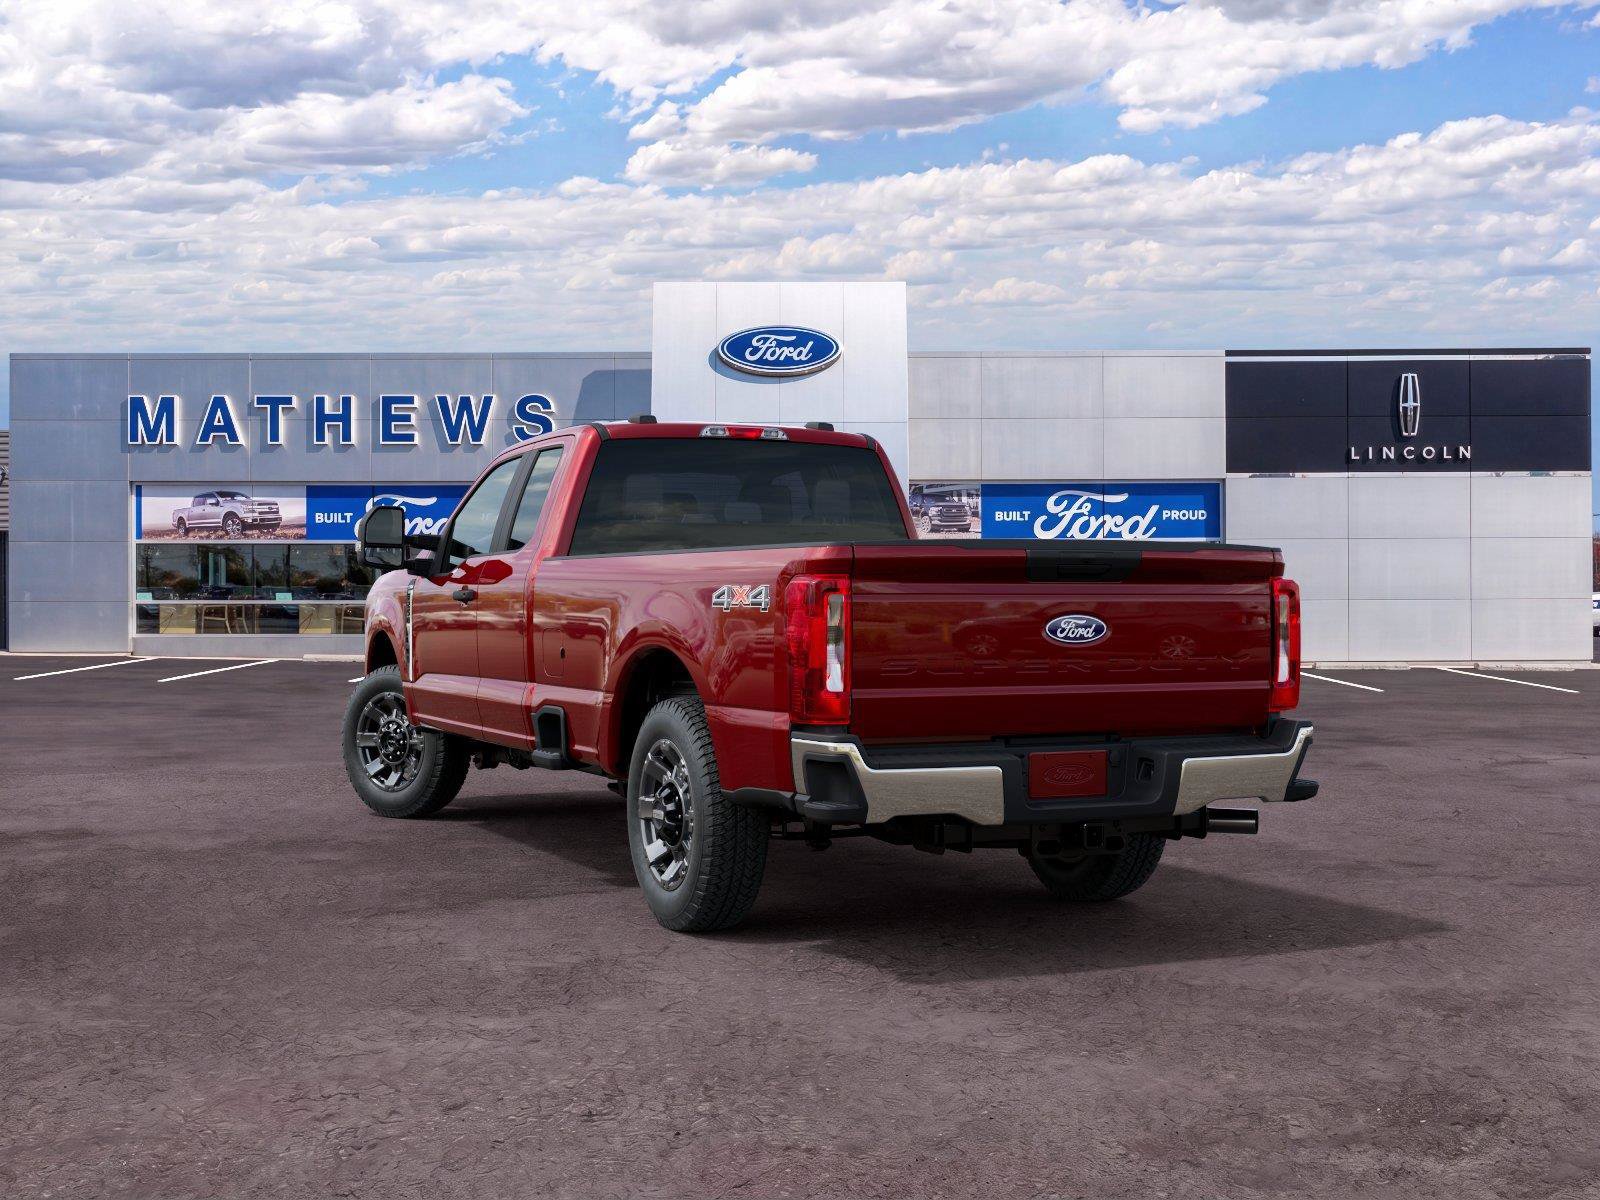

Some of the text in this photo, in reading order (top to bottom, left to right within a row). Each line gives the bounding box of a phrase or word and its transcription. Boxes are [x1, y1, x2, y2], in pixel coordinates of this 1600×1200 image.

[744, 334, 814, 361] Ford
[127, 393, 556, 446] MATHEWS
[1350, 445, 1472, 460] LINCOLN
[314, 512, 354, 524] BUILT
[994, 489, 1208, 540] BUILT Ford PROUD
[1056, 618, 1096, 638] Ford
[880, 654, 1251, 676] SUPER DUTY
